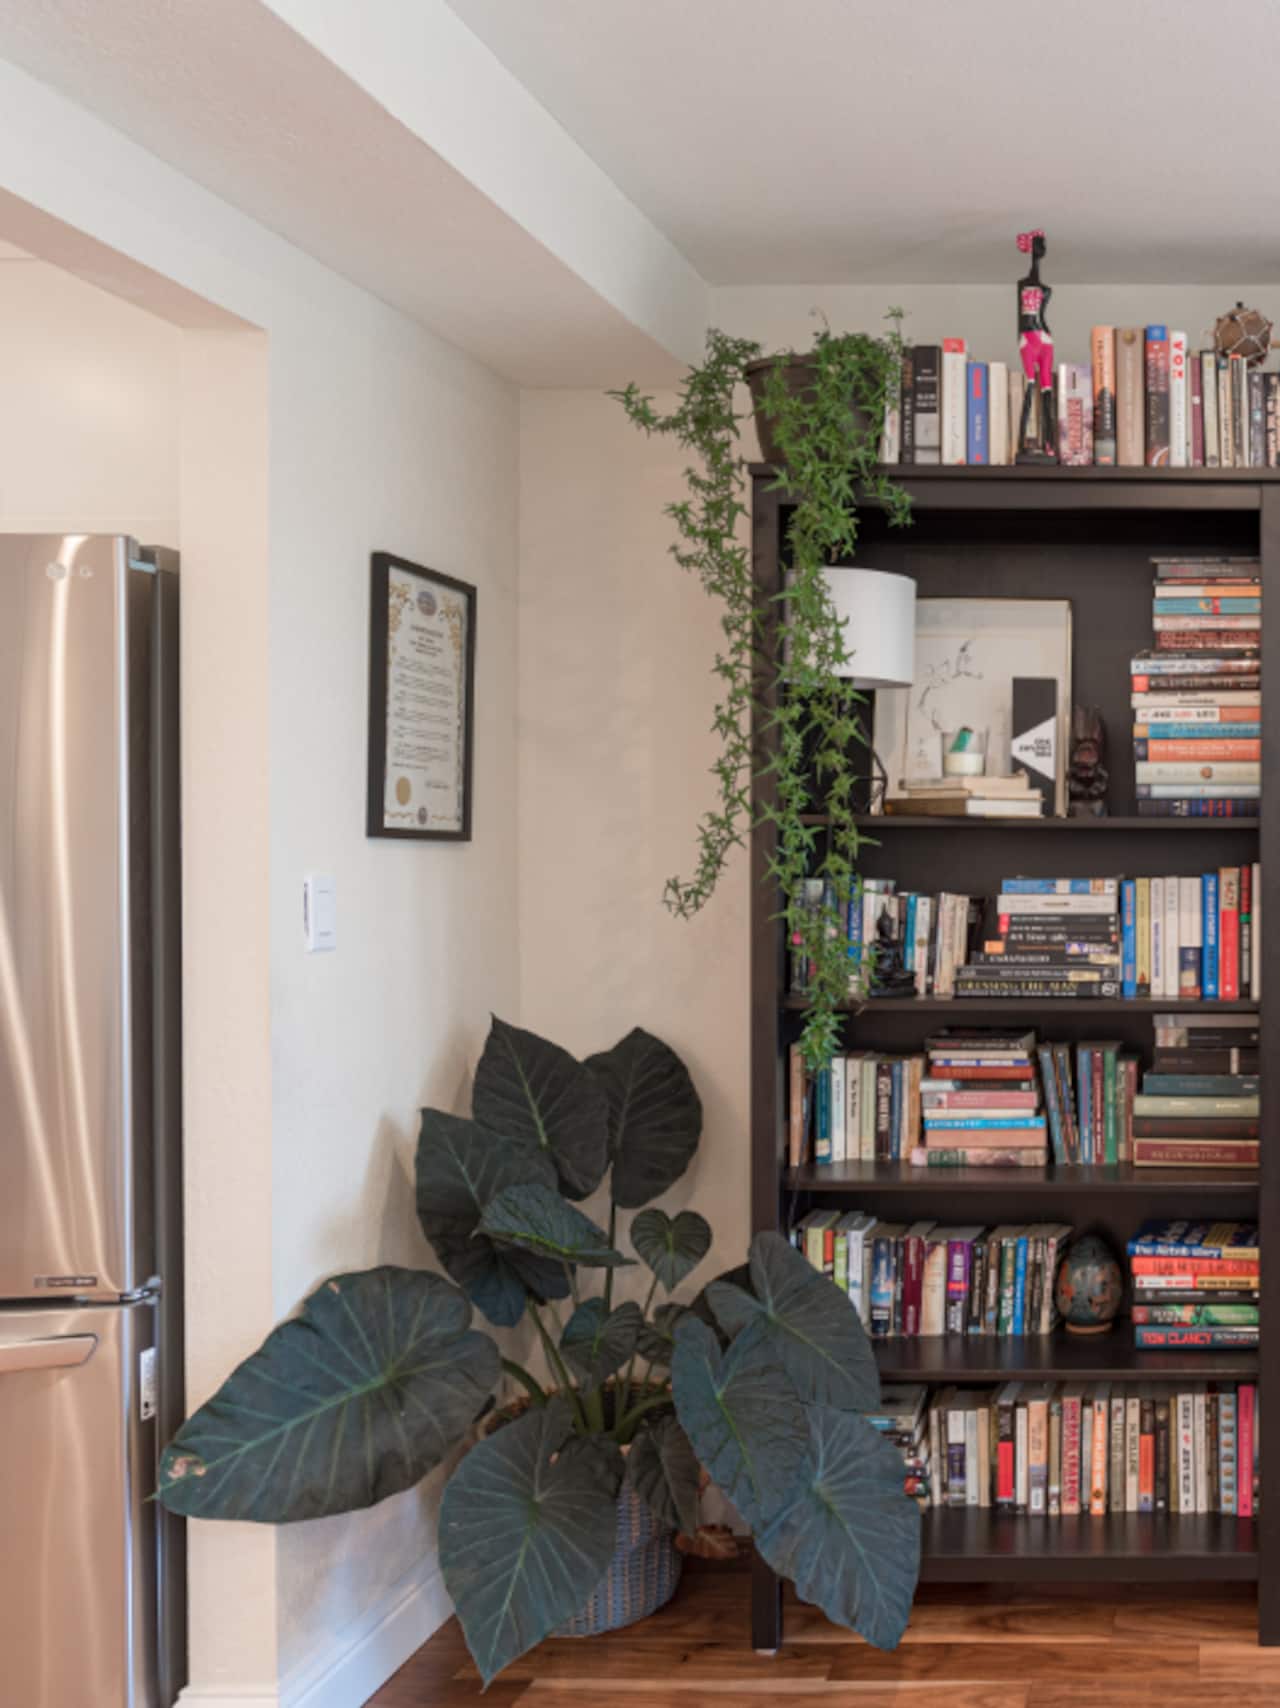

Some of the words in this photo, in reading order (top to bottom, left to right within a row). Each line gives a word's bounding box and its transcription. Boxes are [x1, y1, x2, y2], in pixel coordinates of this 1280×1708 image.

[1172, 340, 1184, 379] VOX
[1142, 1332, 1166, 1345] TOM
[1167, 1332, 1212, 1345] CLANCY
